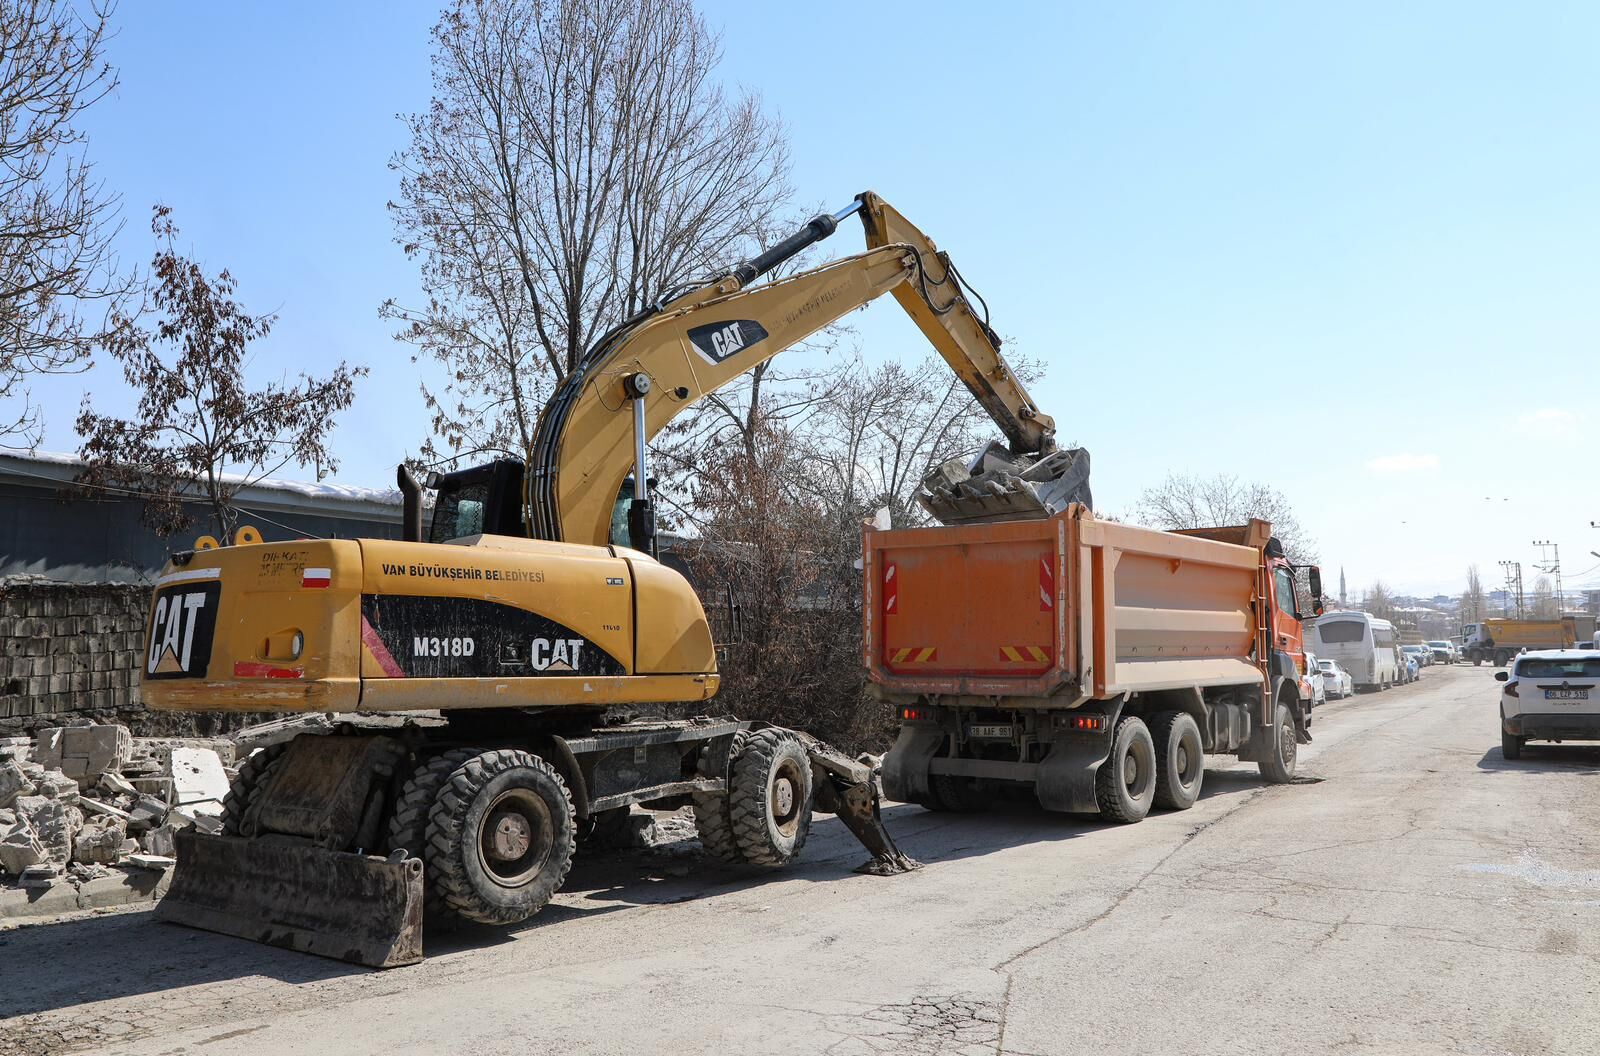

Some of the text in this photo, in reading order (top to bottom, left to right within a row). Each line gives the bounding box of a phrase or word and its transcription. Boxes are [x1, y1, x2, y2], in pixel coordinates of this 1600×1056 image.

[711, 321, 745, 358] CAT
[382, 562, 545, 583] VAN BÜYÜKŞEHİR BELEDİYESİ
[148, 592, 207, 674] CAT
[413, 637, 475, 657] M318D
[531, 637, 584, 671] CAT
